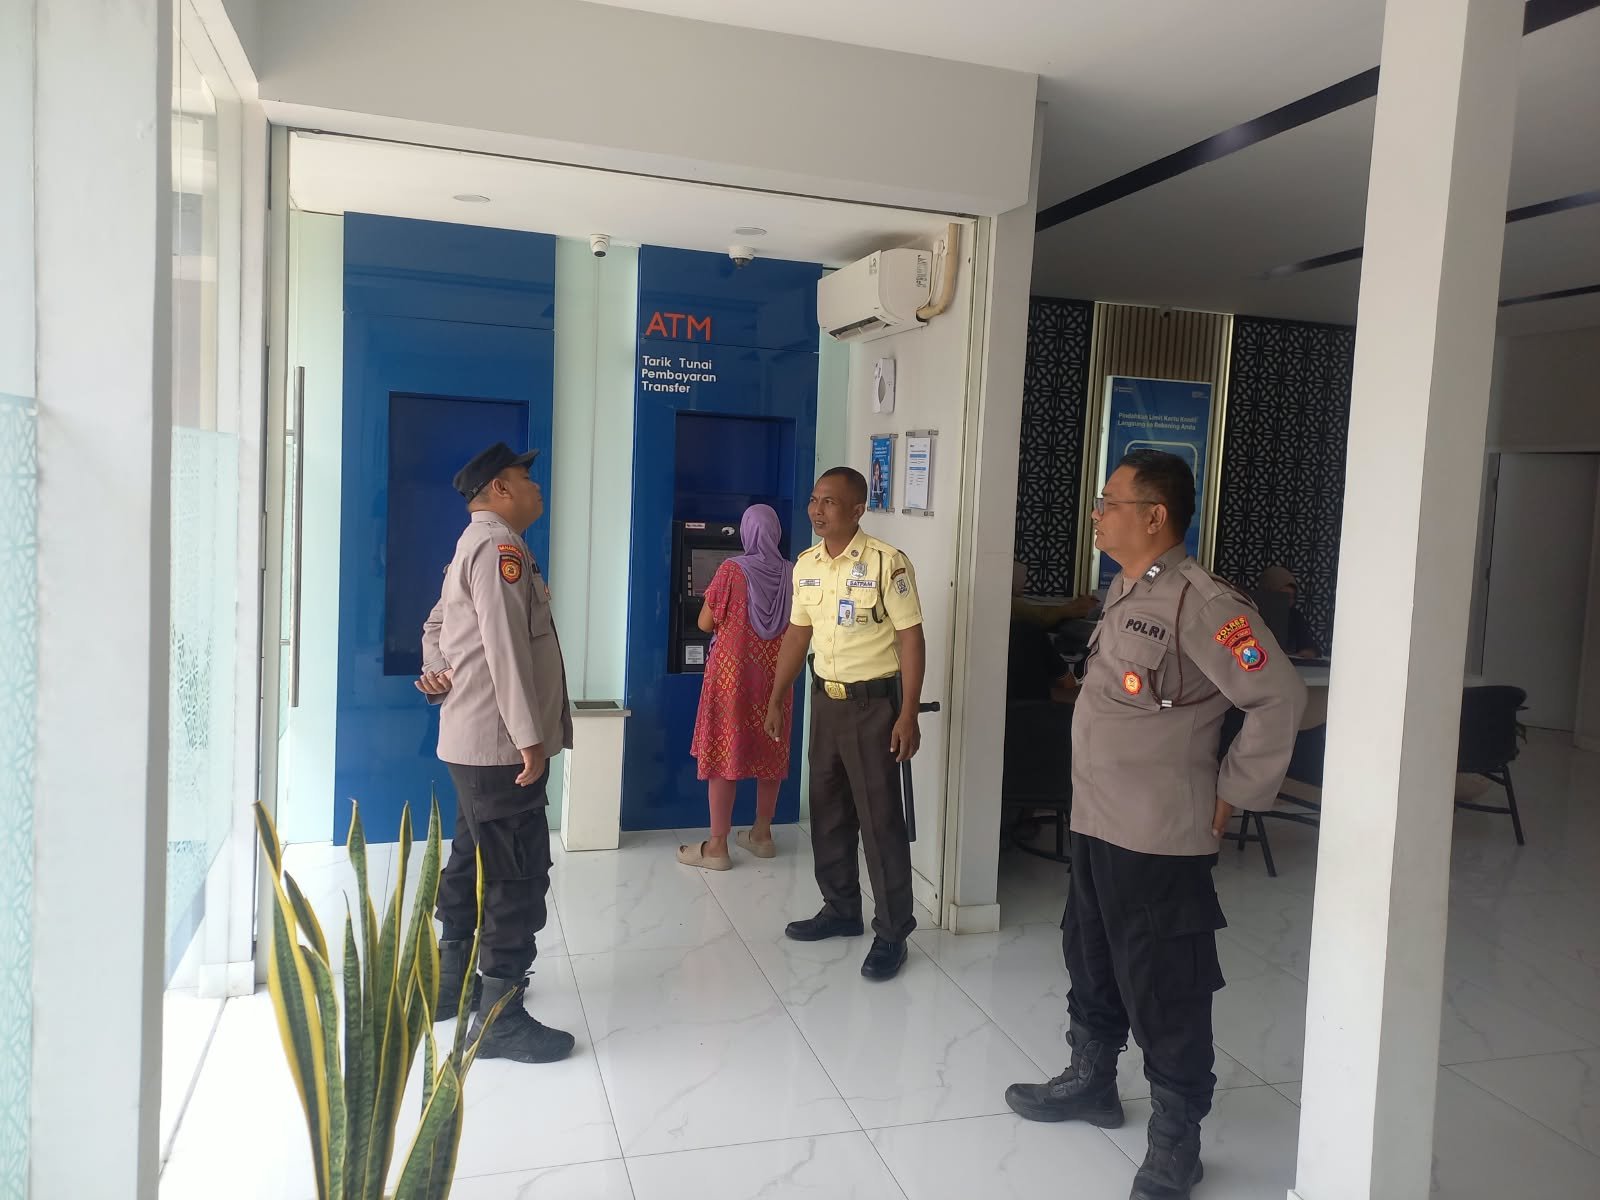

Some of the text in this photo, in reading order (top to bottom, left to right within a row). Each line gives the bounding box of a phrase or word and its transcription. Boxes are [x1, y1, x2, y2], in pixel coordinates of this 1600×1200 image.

[645, 311, 713, 342] ATM
[642, 355, 712, 370] Tarik Tunai
[641, 368, 717, 383] Pembayaran
[641, 380, 691, 394] Transfer
[1117, 420, 1146, 428] Langsung
[1180, 423, 1196, 431] Anda
[849, 580, 873, 588] SATPAM
[1125, 618, 1166, 641] POLRI
[1216, 617, 1246, 641] POLRES
